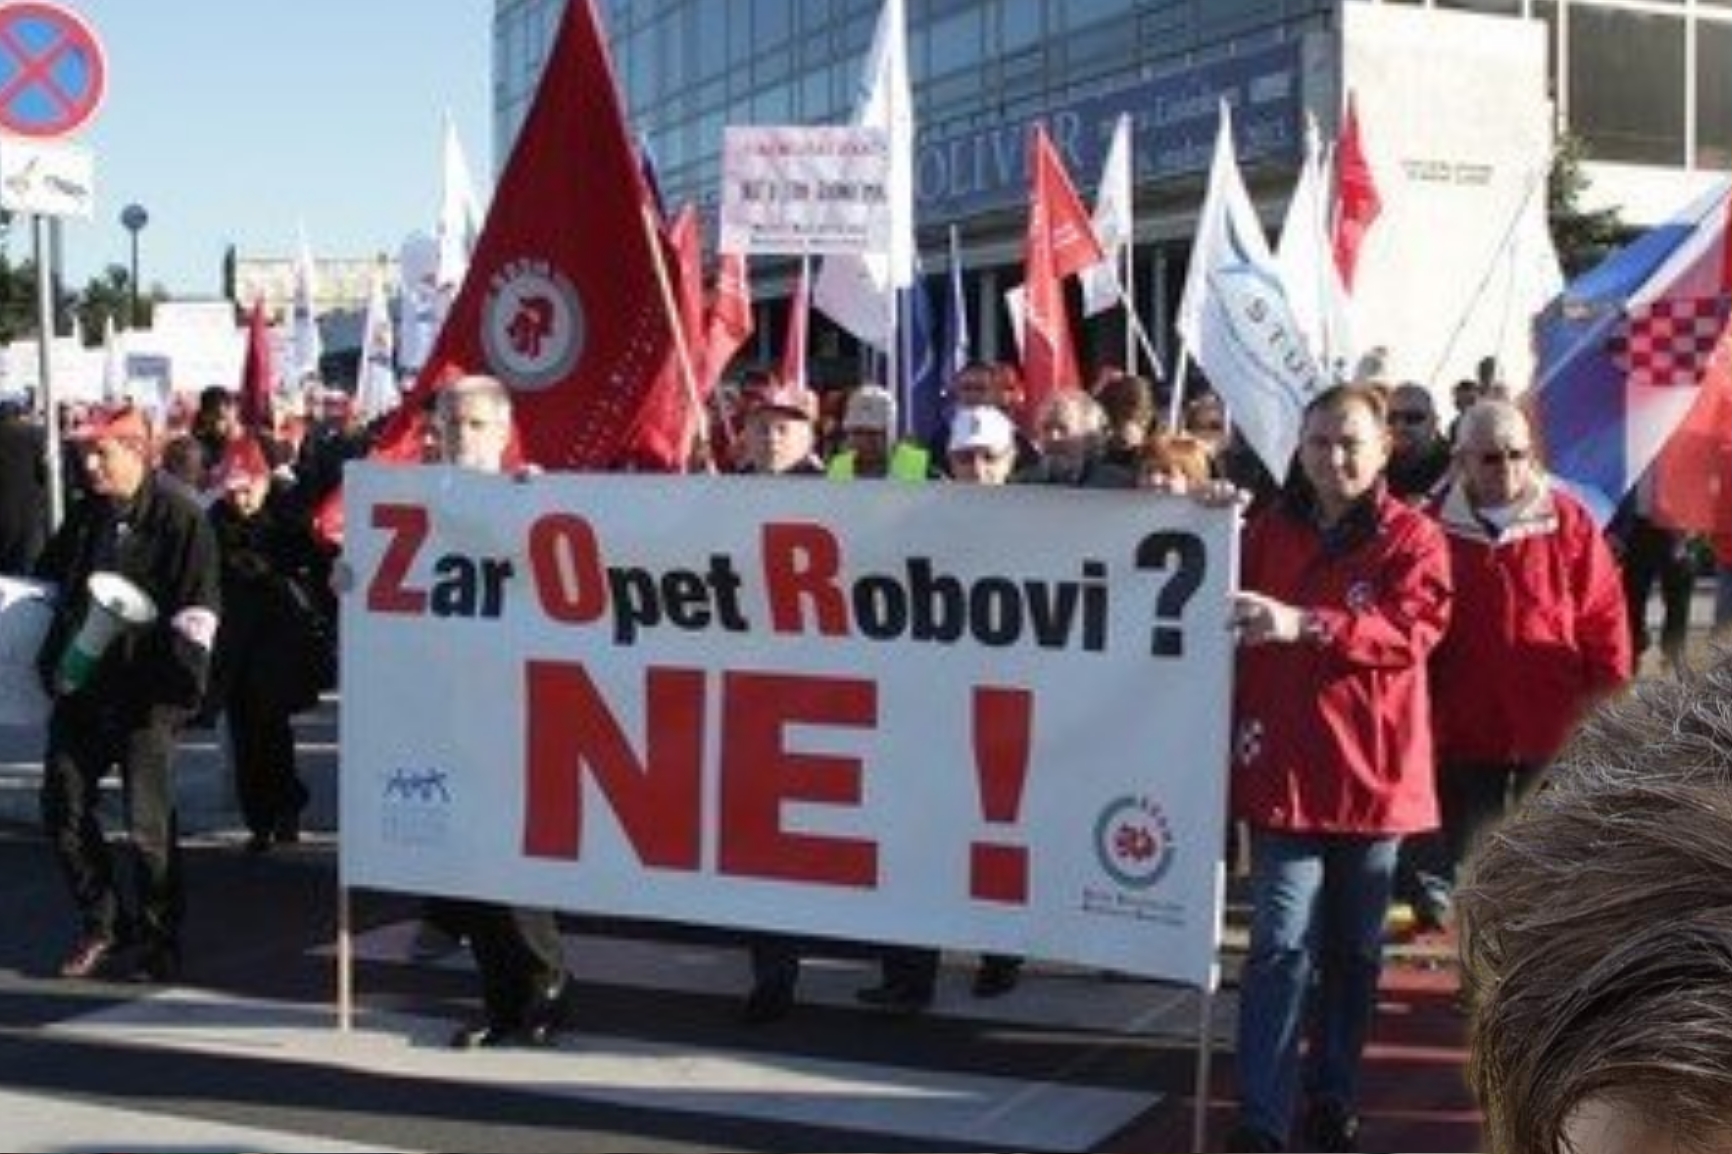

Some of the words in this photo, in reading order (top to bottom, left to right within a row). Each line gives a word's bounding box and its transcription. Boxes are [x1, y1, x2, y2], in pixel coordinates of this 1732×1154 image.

[366, 503, 515, 618] Zar
[527, 512, 748, 645] Opet
[761, 522, 1108, 652] Robovi
[523, 659, 878, 889] NE
